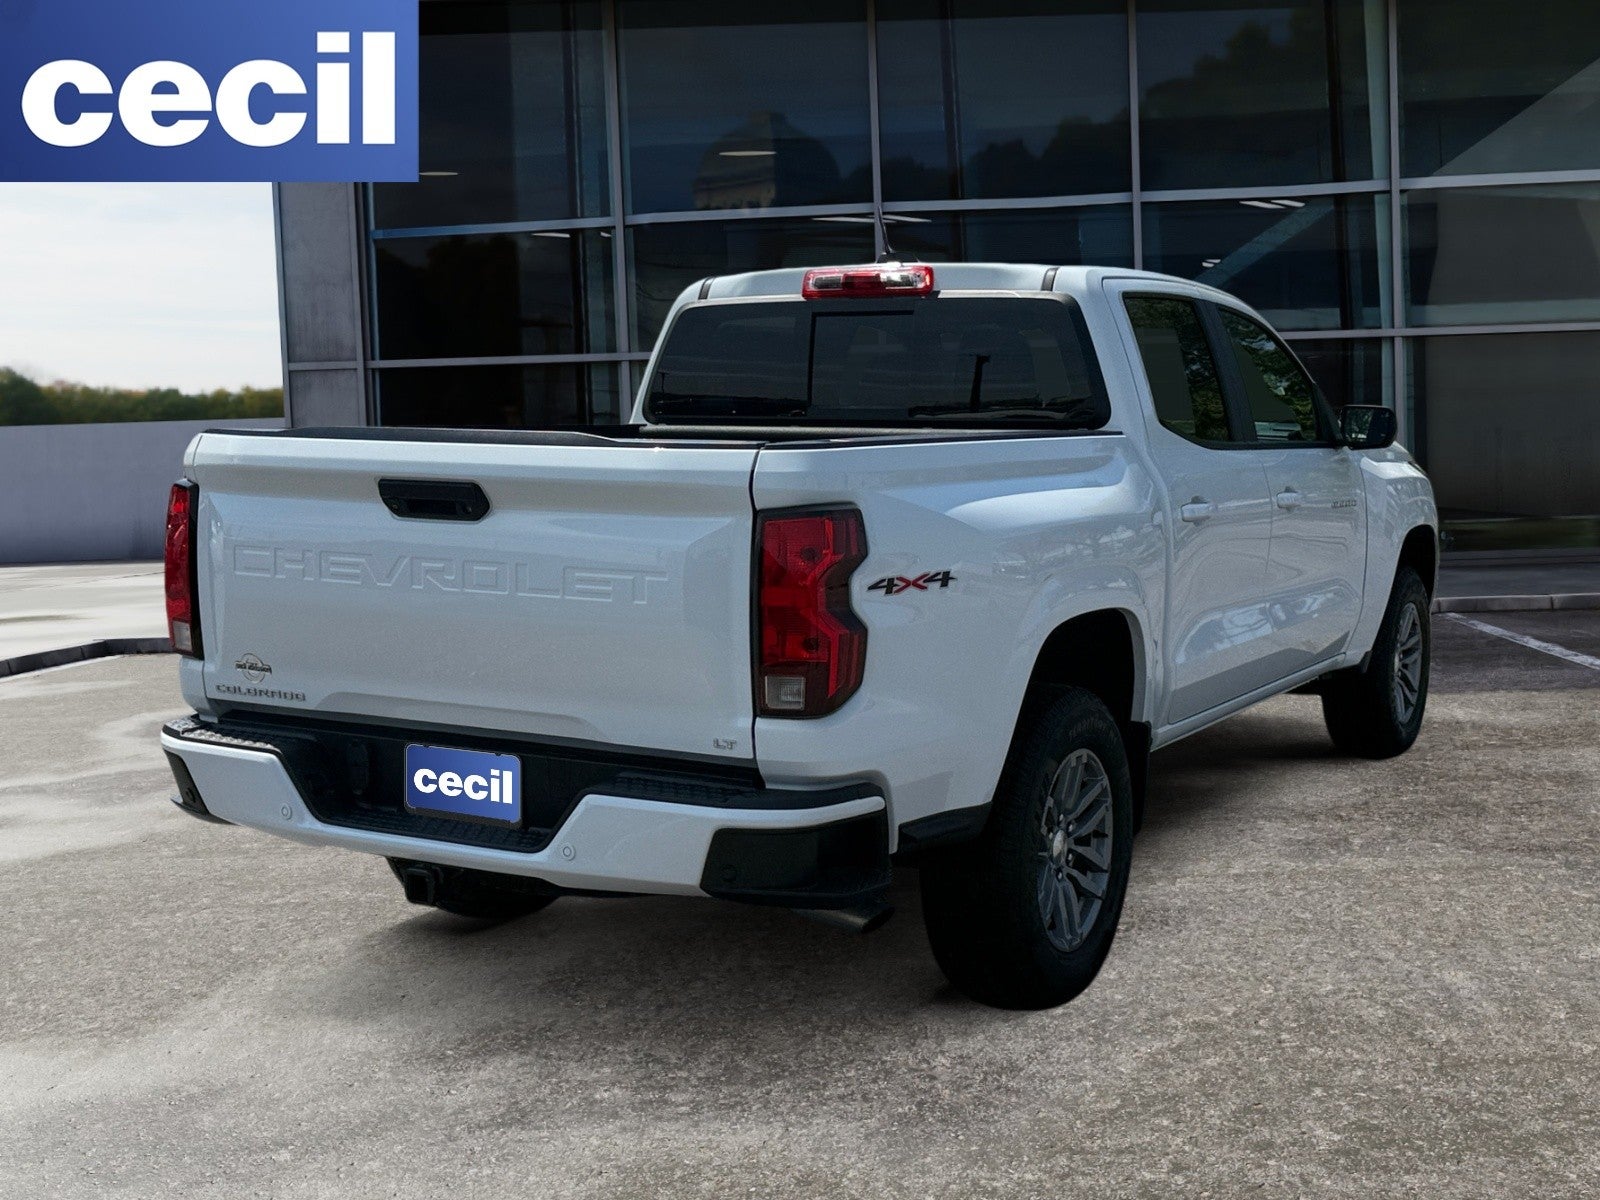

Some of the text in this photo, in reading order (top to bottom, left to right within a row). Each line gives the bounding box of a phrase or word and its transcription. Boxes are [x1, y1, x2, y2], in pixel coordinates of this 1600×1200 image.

[233, 544, 669, 606] CHEVROLET
[712, 737, 737, 750] LT
[413, 768, 513, 805] cecil
